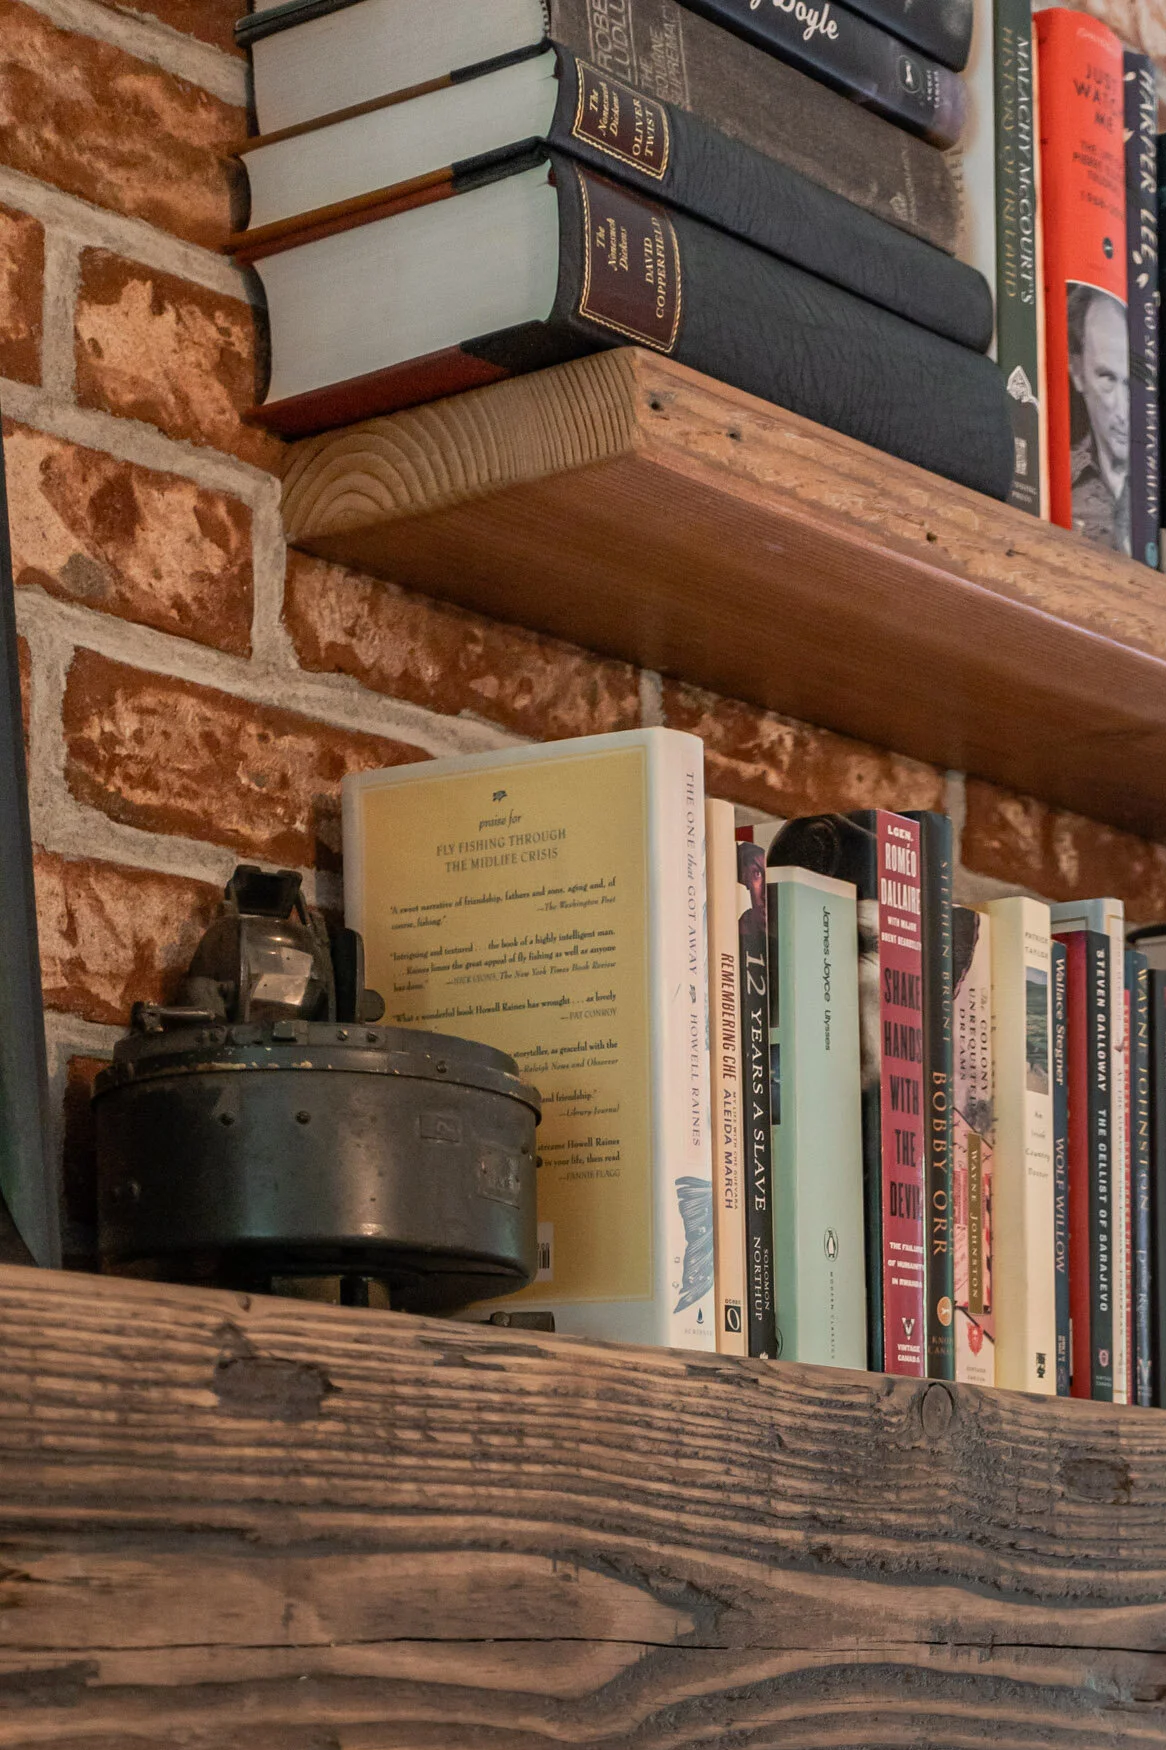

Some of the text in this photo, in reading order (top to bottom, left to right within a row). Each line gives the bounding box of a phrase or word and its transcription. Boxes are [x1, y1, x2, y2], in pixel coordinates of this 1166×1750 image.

[590, 89, 599, 112] The
[1002, 28, 1015, 136] HISTORY
[610, 91, 620, 137] Dickens
[632, 98, 644, 156] OLIVER
[645, 106, 655, 157] TWIST
[1017, 36, 1034, 306] MALACHY McCOURT'S
[1140, 69, 1157, 263] HARPER LEE
[619, 226, 629, 271] Dickens
[644, 237, 654, 284] DAVID
[651, 217, 667, 318] COPPERFIELD
[1004, 187, 1016, 298] IRELAND
[436, 828, 566, 857] FLY FISHING THROUGH
[508, 809, 521, 828] for
[445, 848, 558, 872] THE MIDLIFE CRISIS
[885, 842, 916, 877] ROMÉO
[881, 878, 920, 915] DALLAIRE
[822, 905, 832, 1052] James Joyce Ulysses
[884, 967, 920, 1012] SHAKE
[721, 952, 737, 1080] REMEMBERING CHE
[884, 1020, 921, 1064] HANDS
[745, 950, 767, 1212] 12 YEARS A SLAVE
[890, 1074, 919, 1116] WITH
[567, 1136, 593, 1149] Howell
[595, 1137, 620, 1147] Raines
[1054, 958, 1066, 1275] Wallace Stegner WOLF WILLOW
[1096, 949, 1108, 1312] STEVEN GALLOWAY THE CELLIST OF SARAJEVO
[724, 1089, 734, 1210] ALEIDA MARCH
[894, 1129, 916, 1167] THE
[932, 1070, 948, 1256] BOBBY ORR
[753, 1238, 763, 1322] NORTHUP
[763, 1249, 771, 1311] SOLOMON
